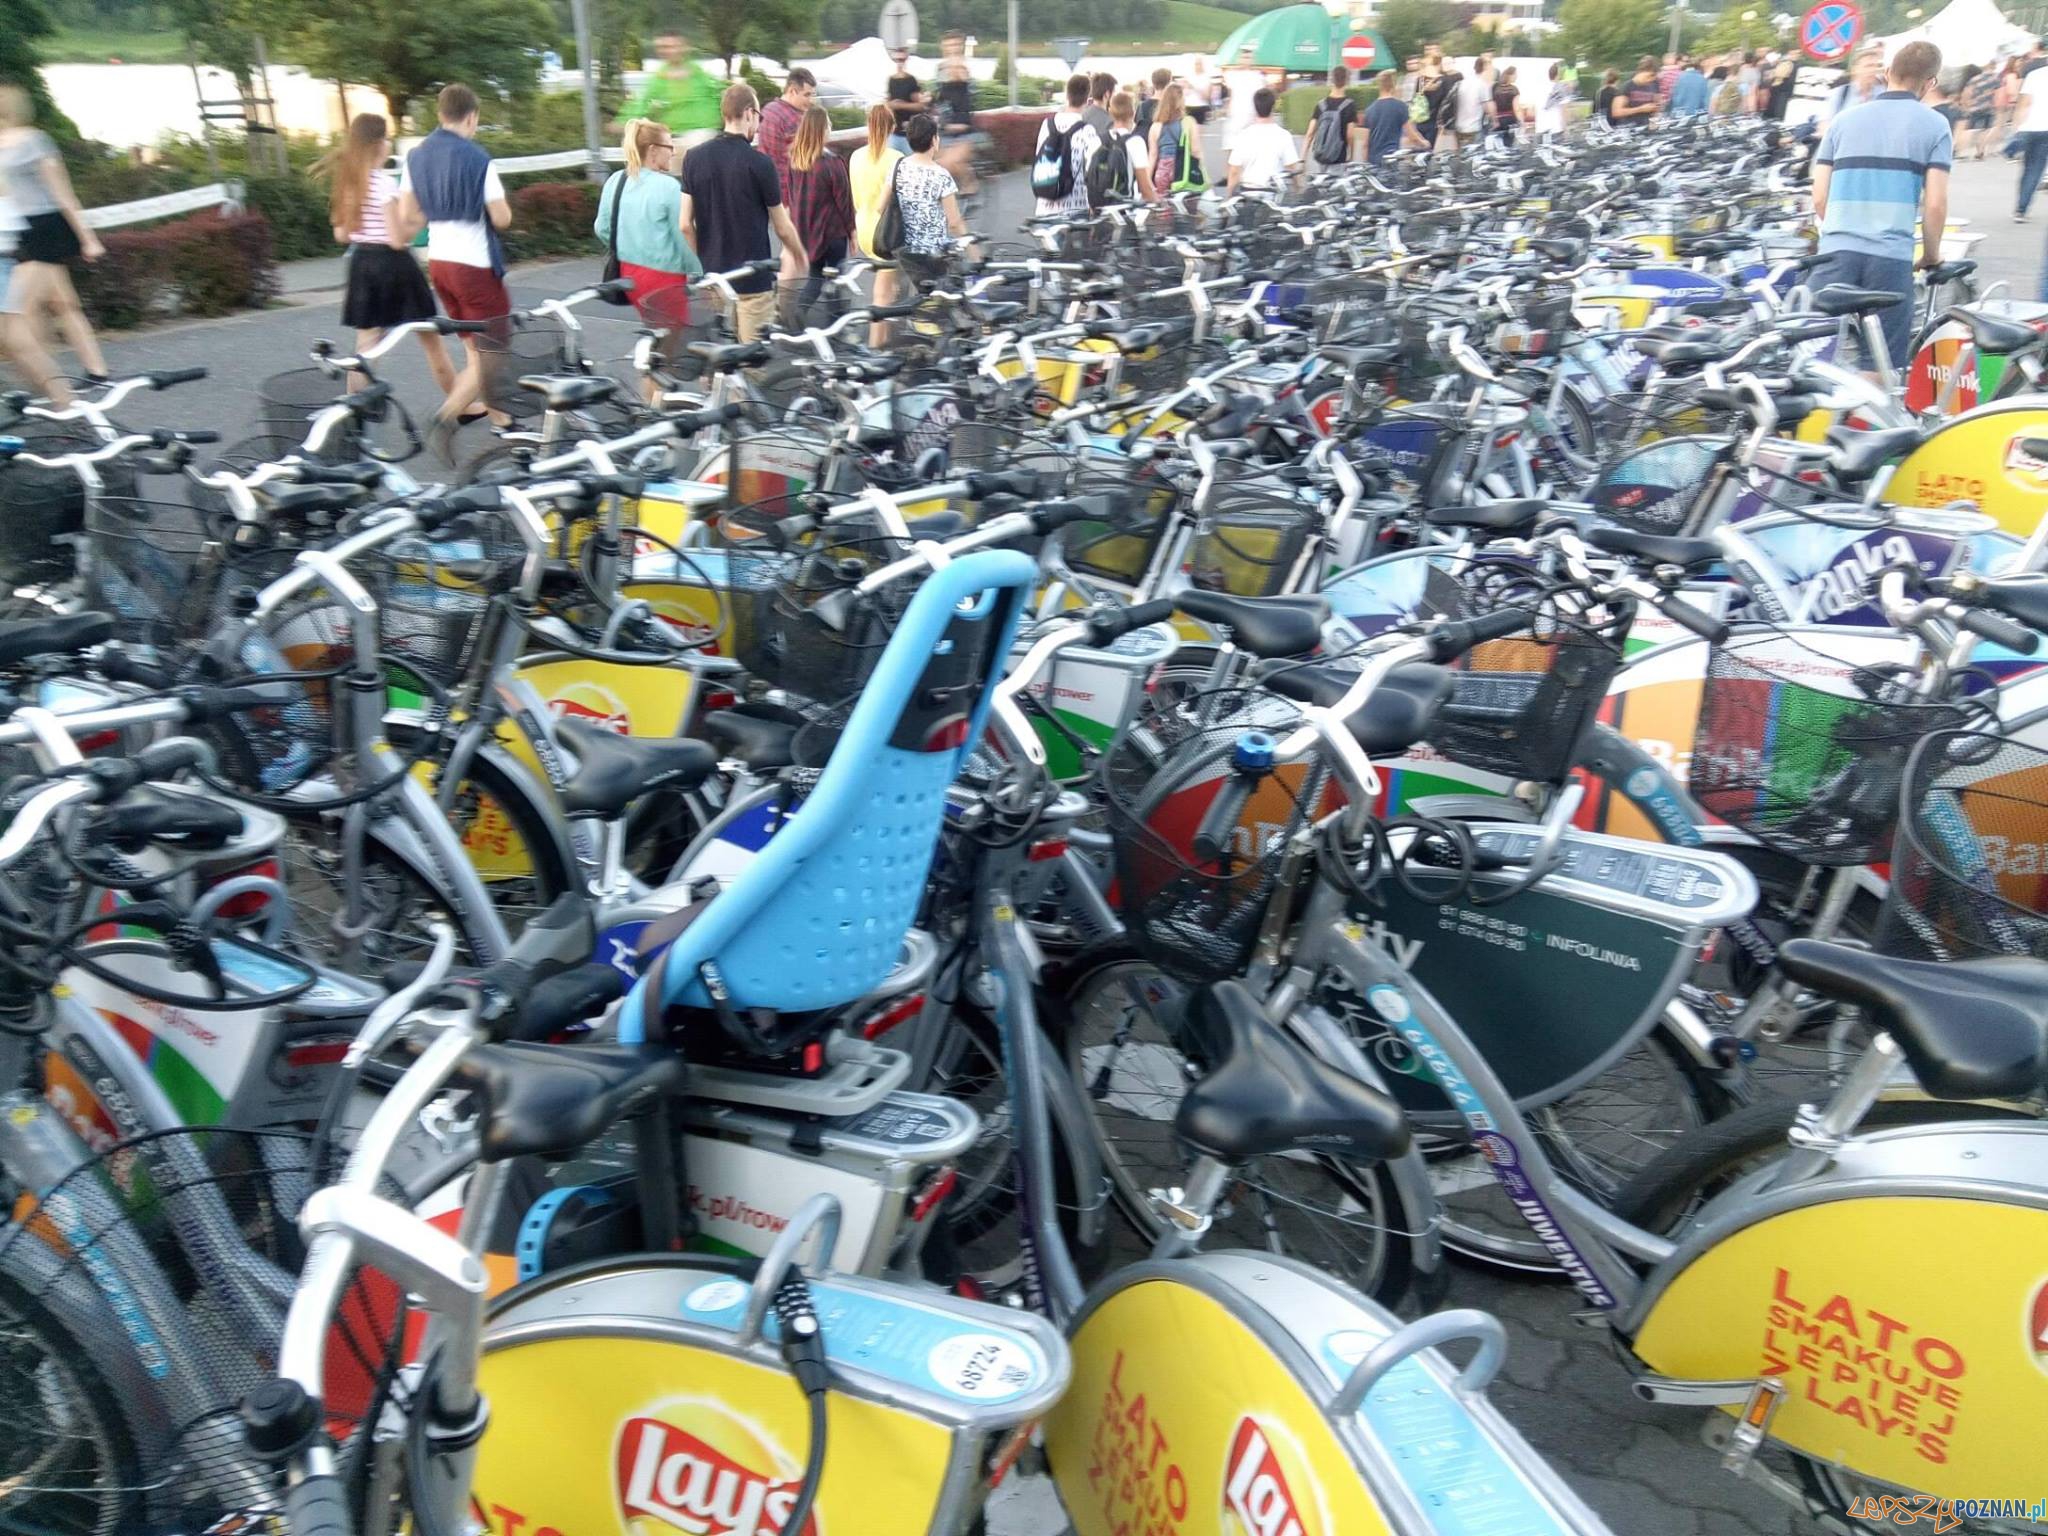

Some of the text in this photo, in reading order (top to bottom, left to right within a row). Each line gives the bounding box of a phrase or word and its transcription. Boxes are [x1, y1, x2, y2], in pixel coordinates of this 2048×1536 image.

[1927, 363, 1982, 393] mBnk
[1546, 934, 1641, 972] INFOLINIA
[1513, 1198, 1615, 1306] JUWENTUS
[957, 1344, 1001, 1390] 68724
[1767, 1305, 1962, 1411] SMAKUJE
[1773, 1267, 1966, 1380] LATO
[1763, 1328, 1955, 1435] LEPIEJ
[1805, 1376, 1949, 1464] LAY'S
[1111, 1350, 1187, 1523] LATO
